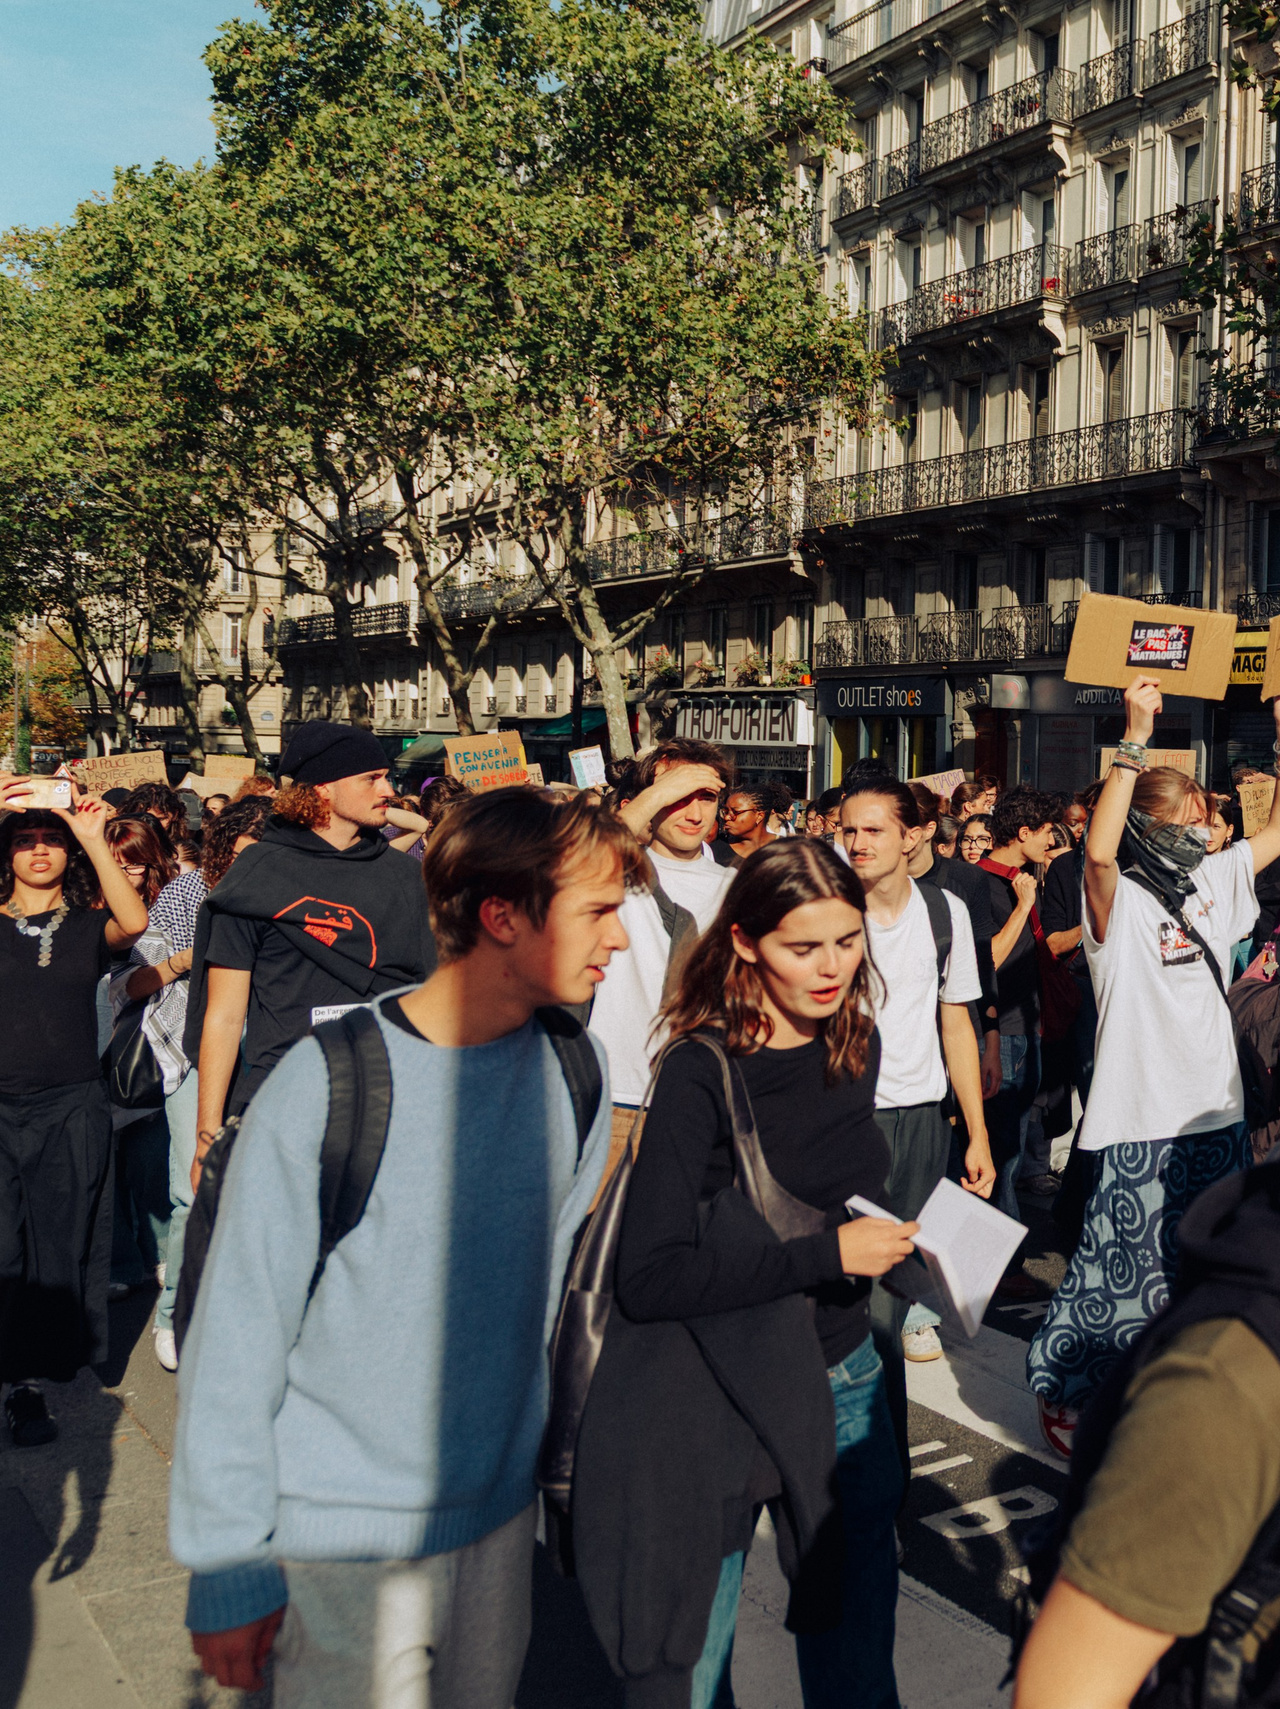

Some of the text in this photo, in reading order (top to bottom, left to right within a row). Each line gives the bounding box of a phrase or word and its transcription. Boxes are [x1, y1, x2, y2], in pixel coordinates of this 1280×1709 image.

[1134, 629, 1146, 639] LE
[1147, 639, 1183, 650] PAS LES
[837, 685, 921, 707] OUTLET shoes
[1074, 689, 1121, 704] AUDILYA
[33, 751, 63, 761] Fayet
[100, 757, 131, 769] POLICE
[134, 754, 163, 765] NOUS
[454, 748, 500, 765] PENSER
[459, 756, 519, 775] SON AVENIR
